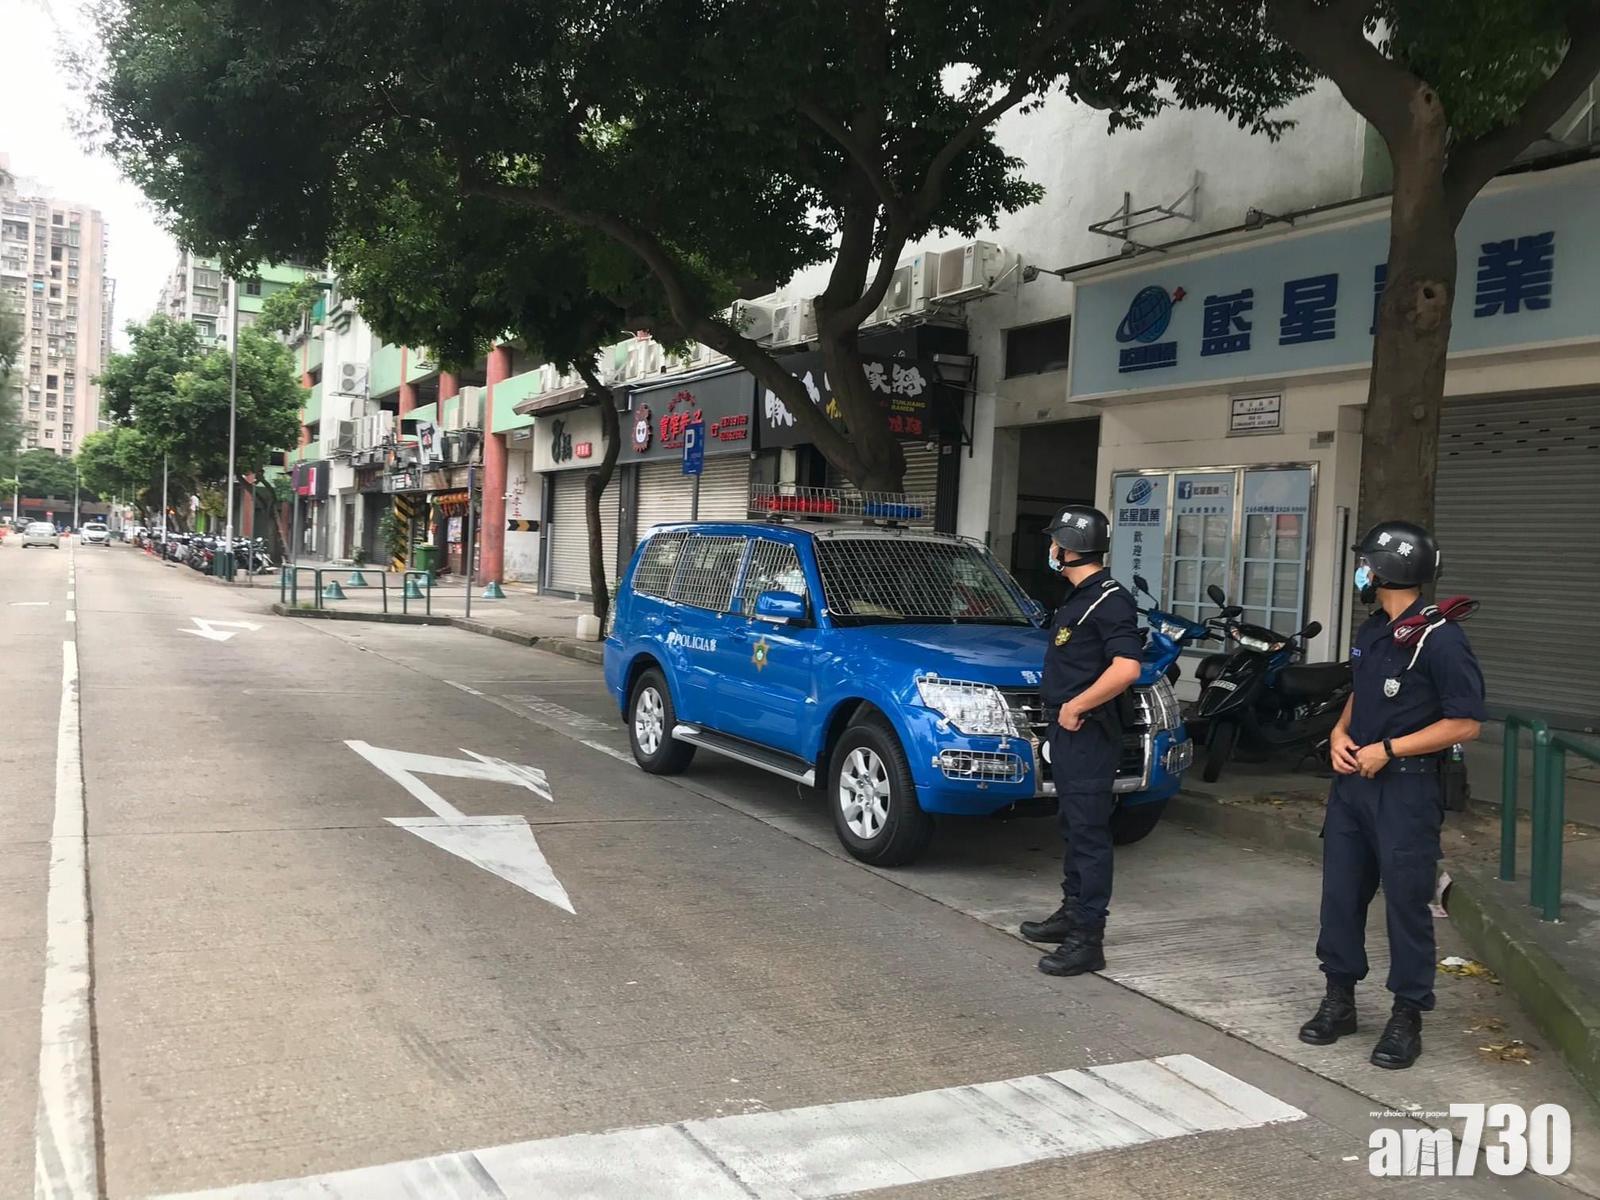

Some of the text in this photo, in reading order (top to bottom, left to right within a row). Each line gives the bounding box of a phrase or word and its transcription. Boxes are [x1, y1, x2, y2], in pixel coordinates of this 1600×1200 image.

[1200, 231, 1555, 356] 藍星業
[684, 429, 695, 460] P
